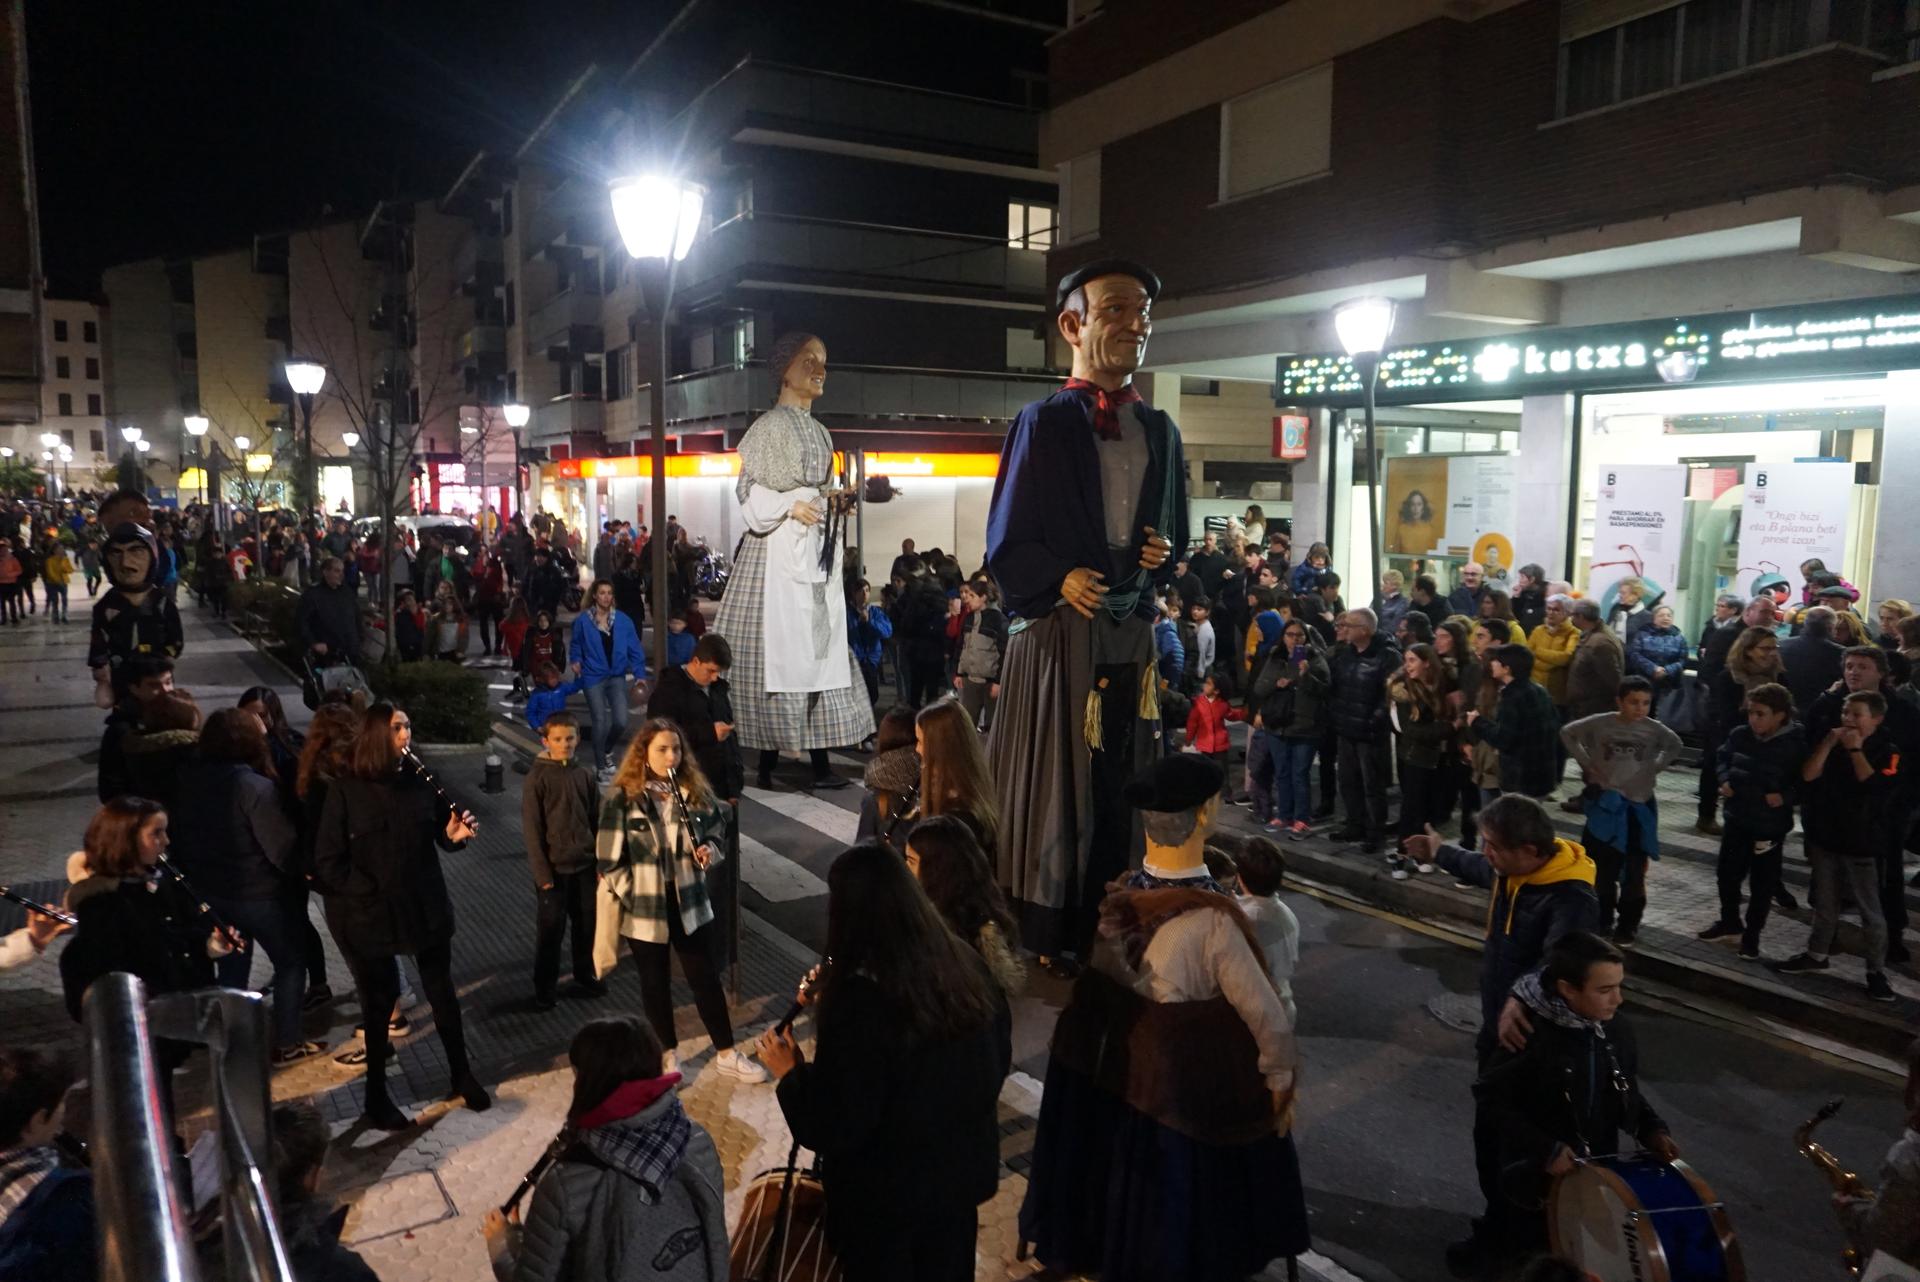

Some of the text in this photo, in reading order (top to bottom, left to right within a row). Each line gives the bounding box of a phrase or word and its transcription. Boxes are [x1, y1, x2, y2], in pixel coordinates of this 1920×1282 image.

[1525, 343, 1647, 374] kutxa
[1756, 473, 1767, 487] B
[1768, 521, 1778, 532] B
